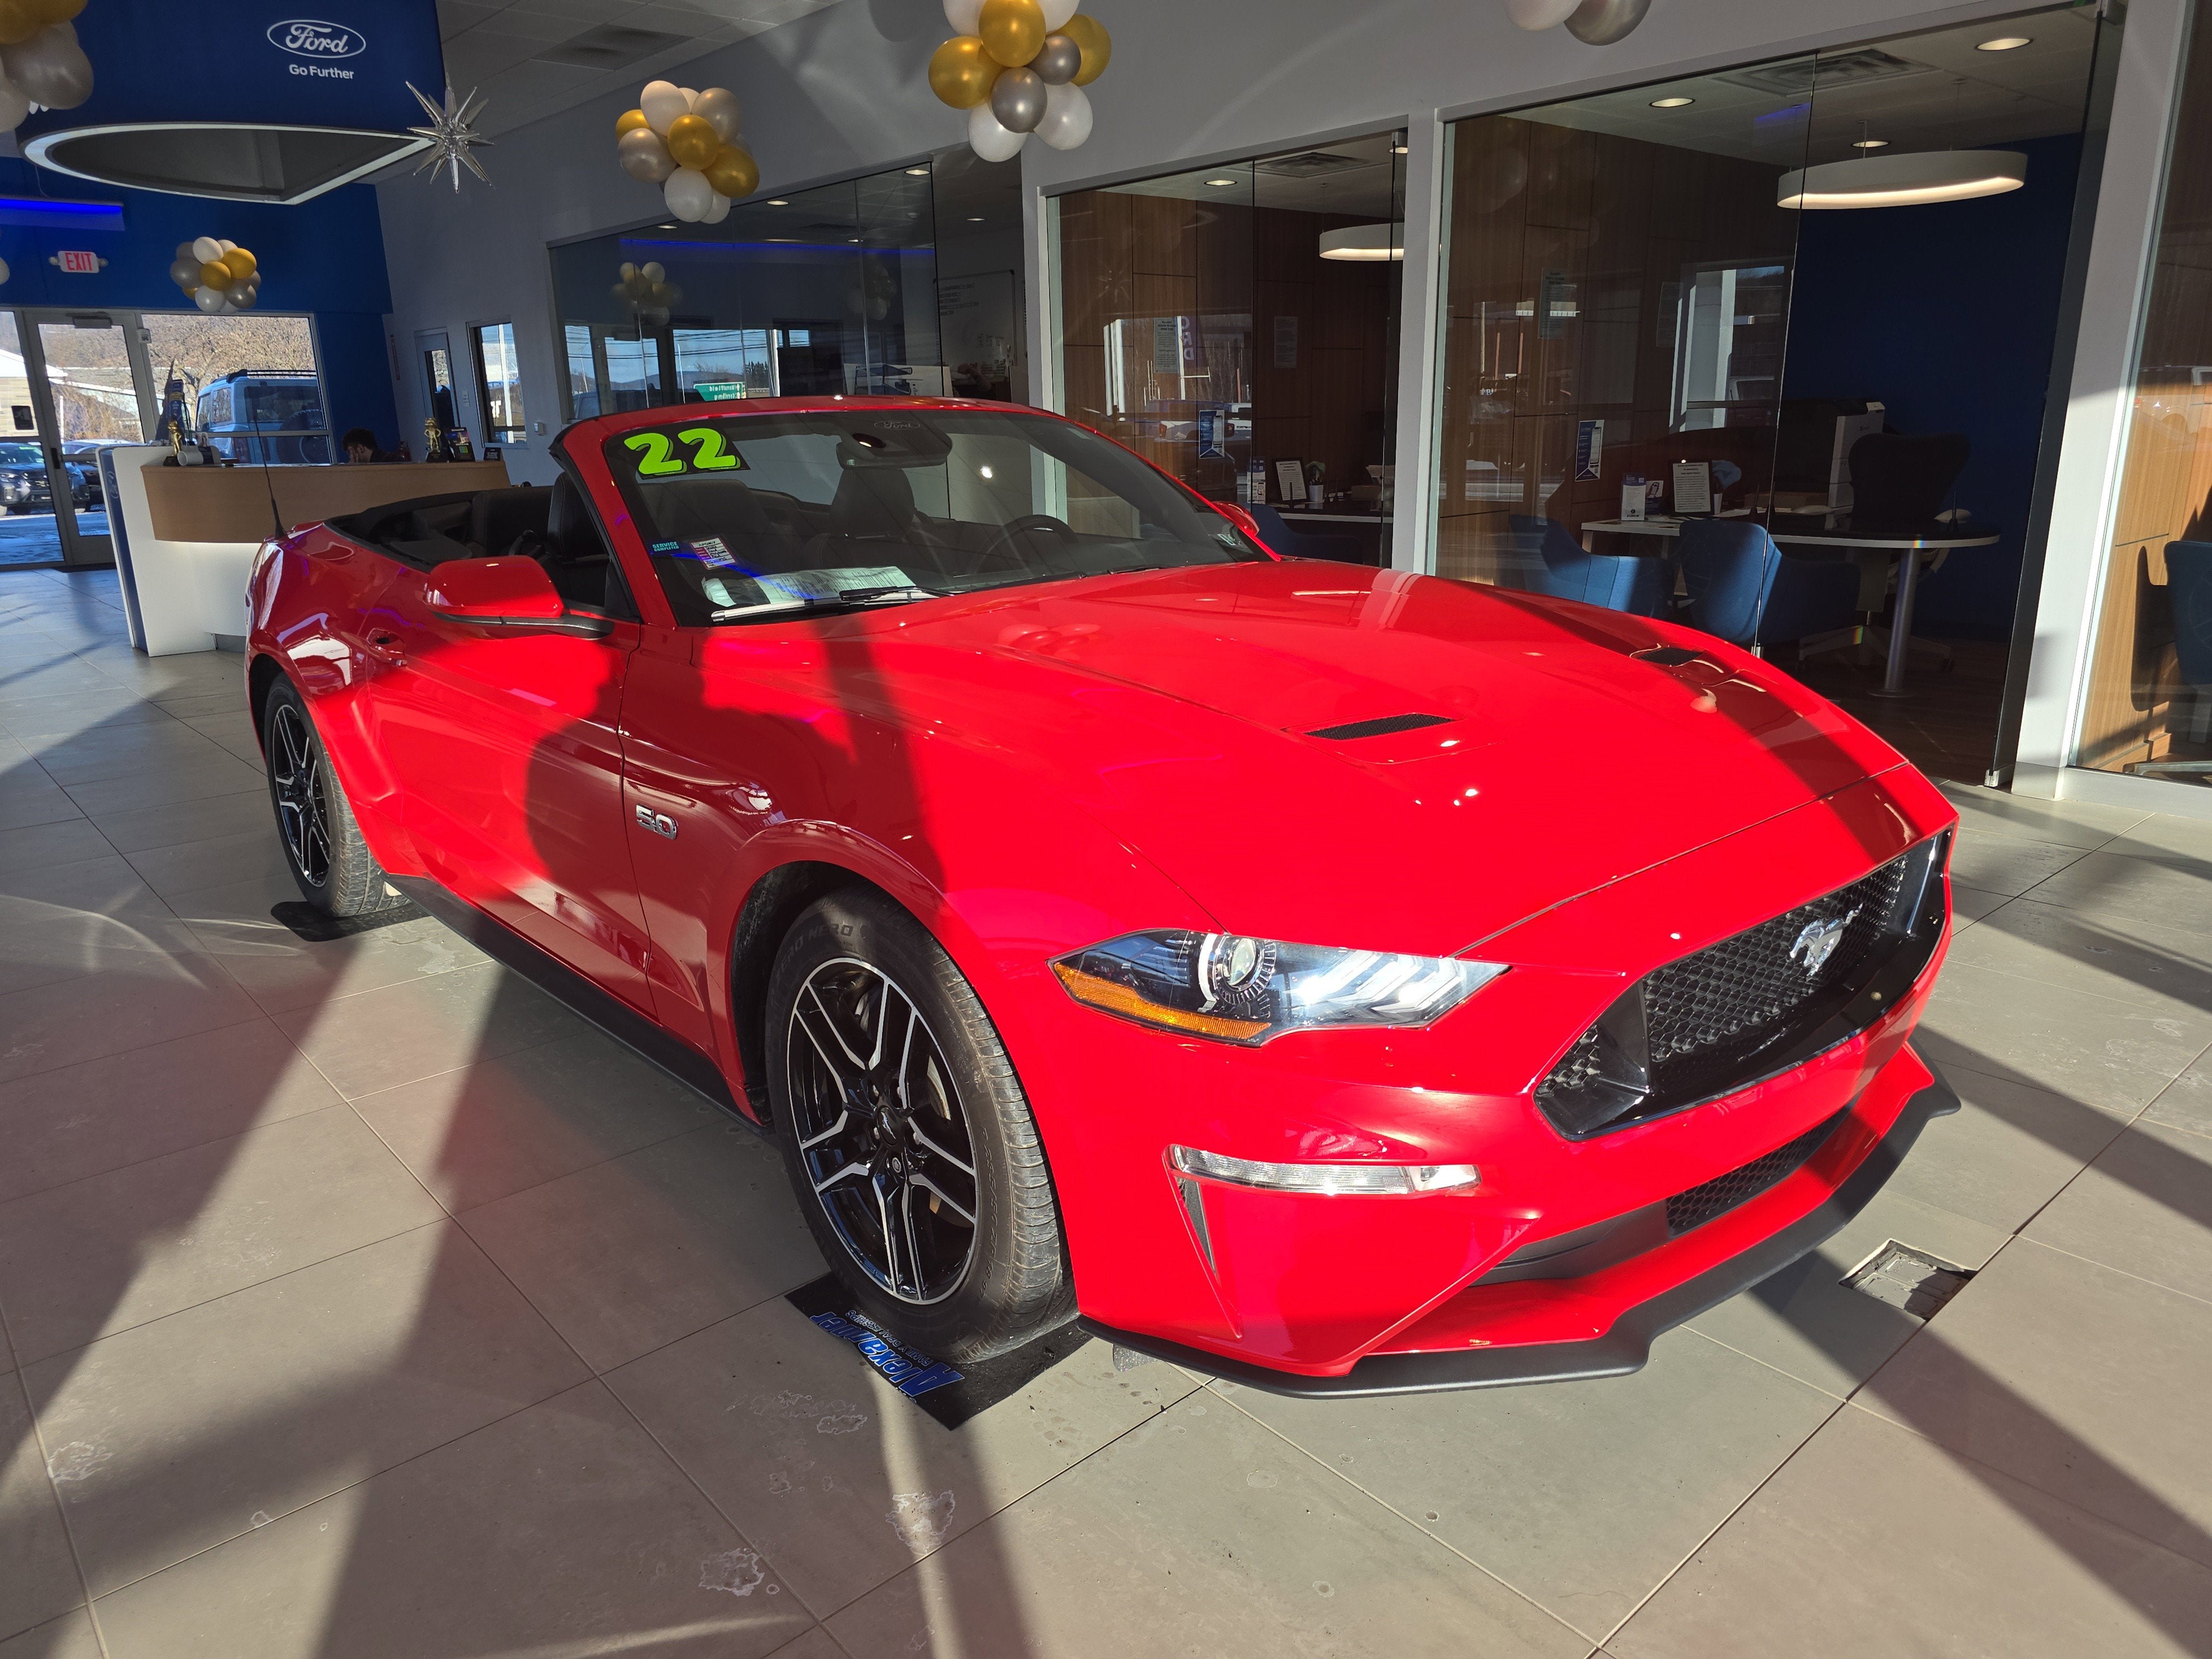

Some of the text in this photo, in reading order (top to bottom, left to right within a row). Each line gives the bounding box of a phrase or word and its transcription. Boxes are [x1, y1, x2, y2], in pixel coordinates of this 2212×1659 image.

[286, 24, 349, 53] Ford
[289, 64, 355, 79] Go Further
[65, 253, 92, 271] EXIT
[624, 428, 741, 475] 22
[636, 804, 678, 840] 5.0
[845, 1309, 933, 1367] FAMILY DEALERSHIPS
